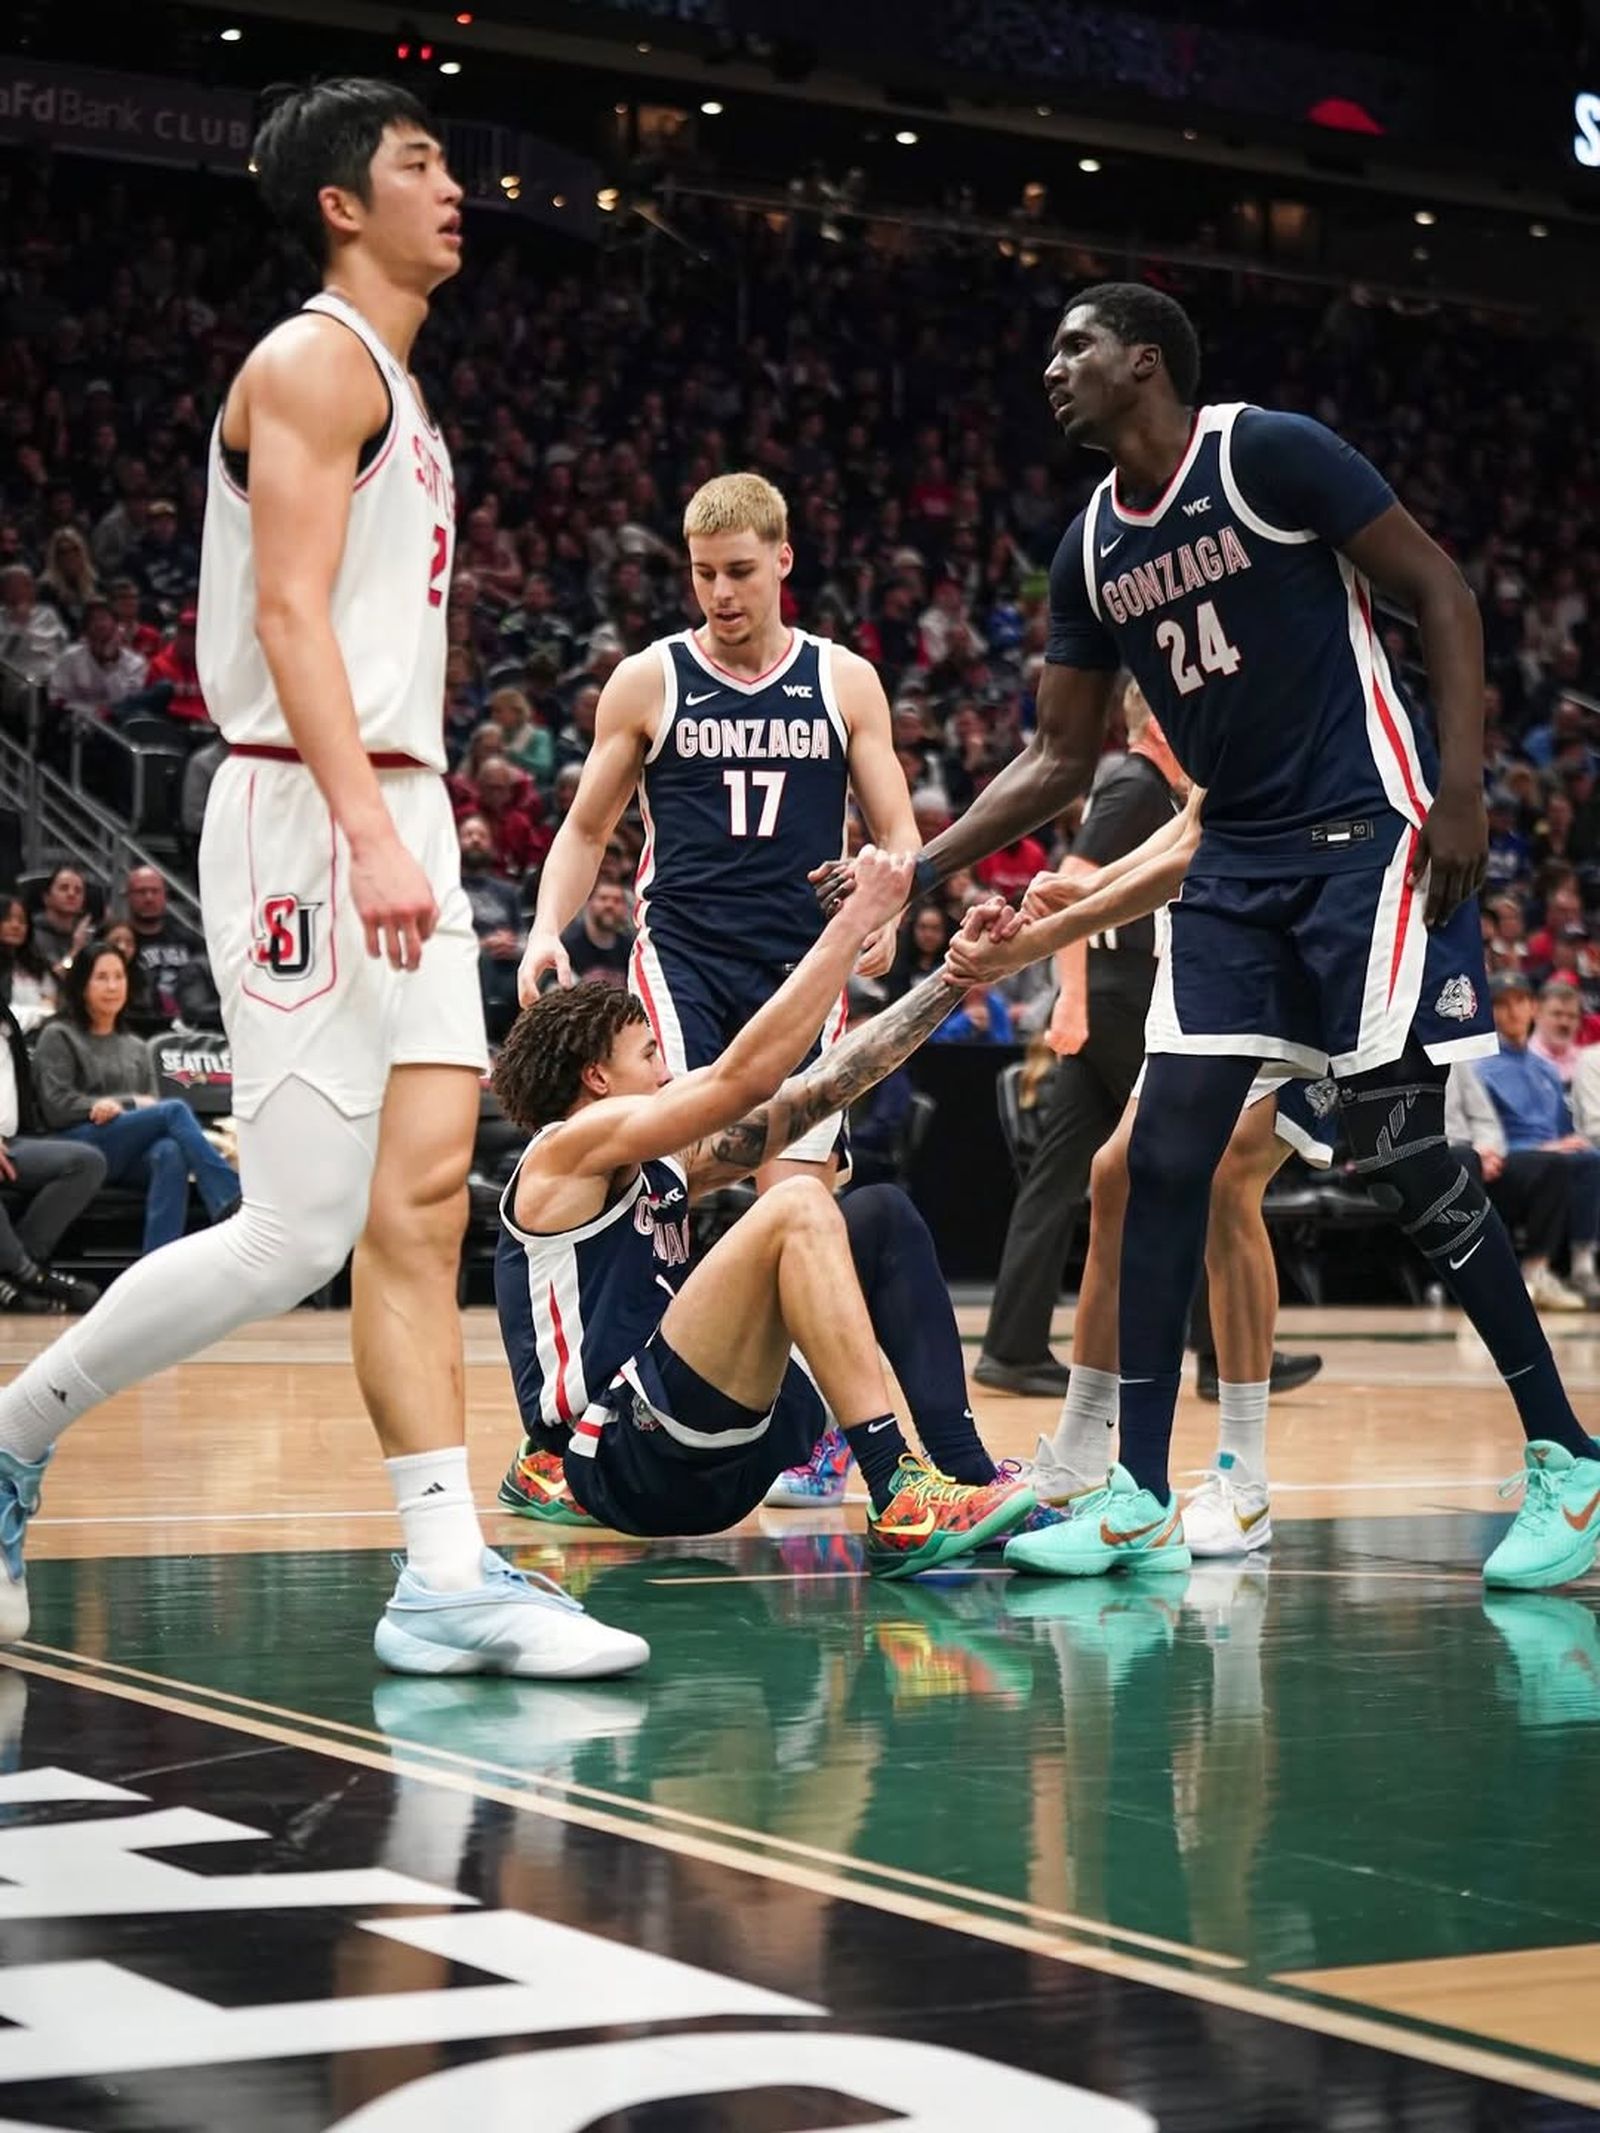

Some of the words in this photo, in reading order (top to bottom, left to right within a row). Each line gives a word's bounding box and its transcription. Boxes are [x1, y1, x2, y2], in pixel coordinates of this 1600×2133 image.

[153, 111, 249, 149] CLUB
[1181, 496, 1212, 517] WCC
[1101, 526, 1252, 625] GONZAGA
[1156, 600, 1241, 695] 24
[782, 684, 813, 698] WCC
[676, 717, 830, 760] GONZAGA
[722, 769, 787, 837] 17
[160, 1050, 233, 1074] SEATTLE
